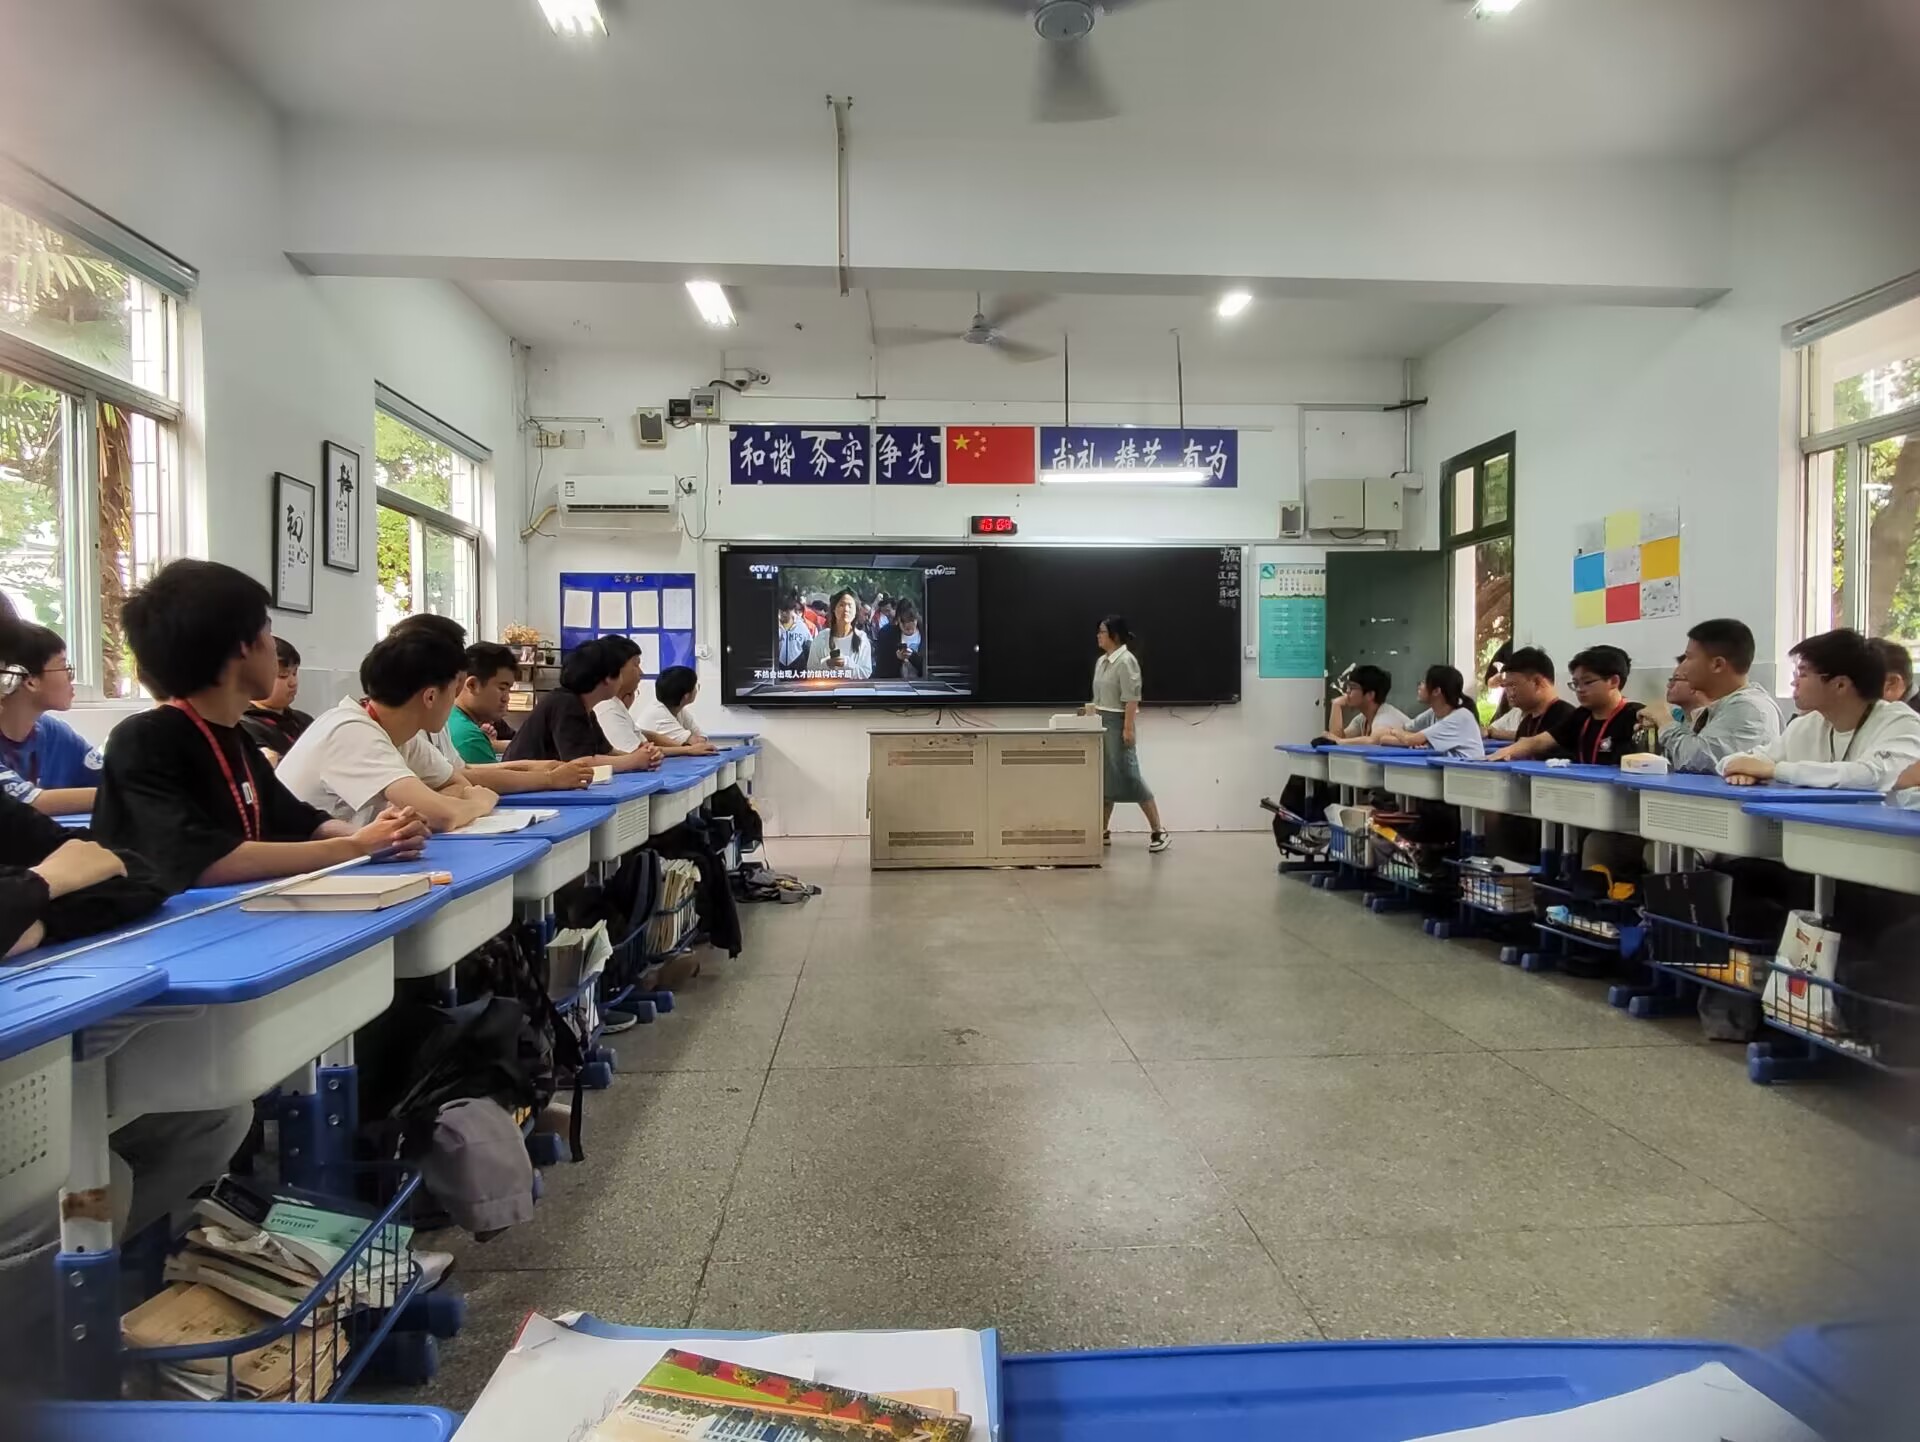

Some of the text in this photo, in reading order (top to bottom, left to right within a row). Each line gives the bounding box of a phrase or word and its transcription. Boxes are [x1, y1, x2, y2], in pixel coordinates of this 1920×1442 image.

[740, 432, 933, 479] 和谐 务实 争先
[1180, 439, 1228, 480] 有为
[749, 565, 770, 573] CCTV
